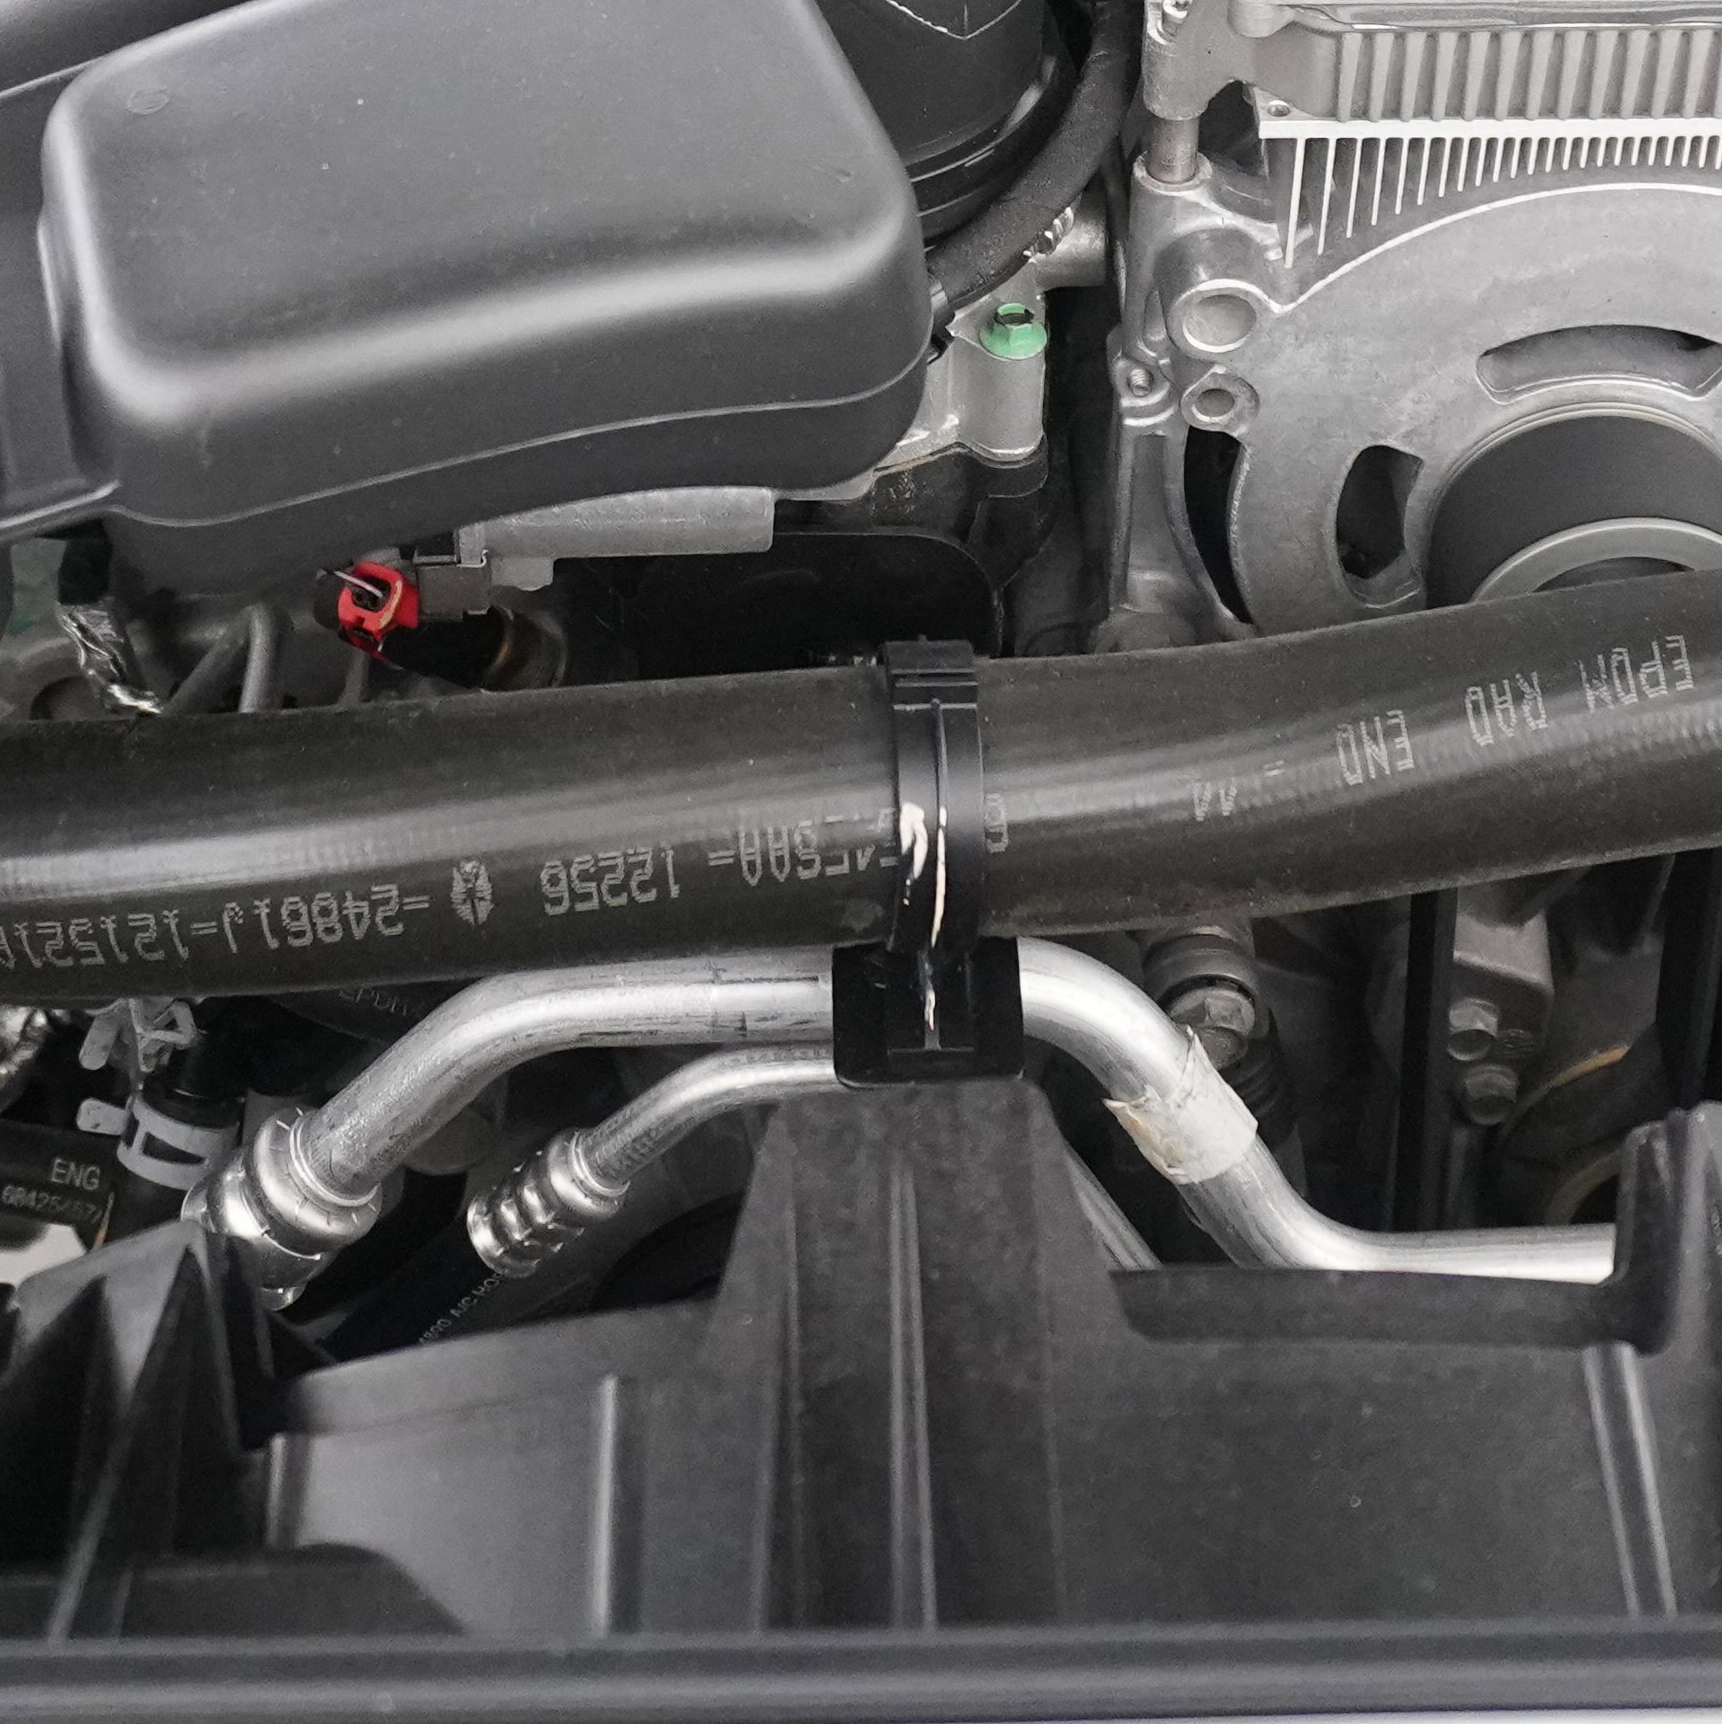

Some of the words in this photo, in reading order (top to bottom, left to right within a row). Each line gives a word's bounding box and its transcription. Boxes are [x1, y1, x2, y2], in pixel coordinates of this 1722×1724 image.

[1463, 672, 1548, 746] RAD
[1578, 633, 1694, 713] EPDM
[1336, 709, 1415, 786] END
[539, 846, 680, 916] 12256
[50, 1156, 102, 1191] ENG
